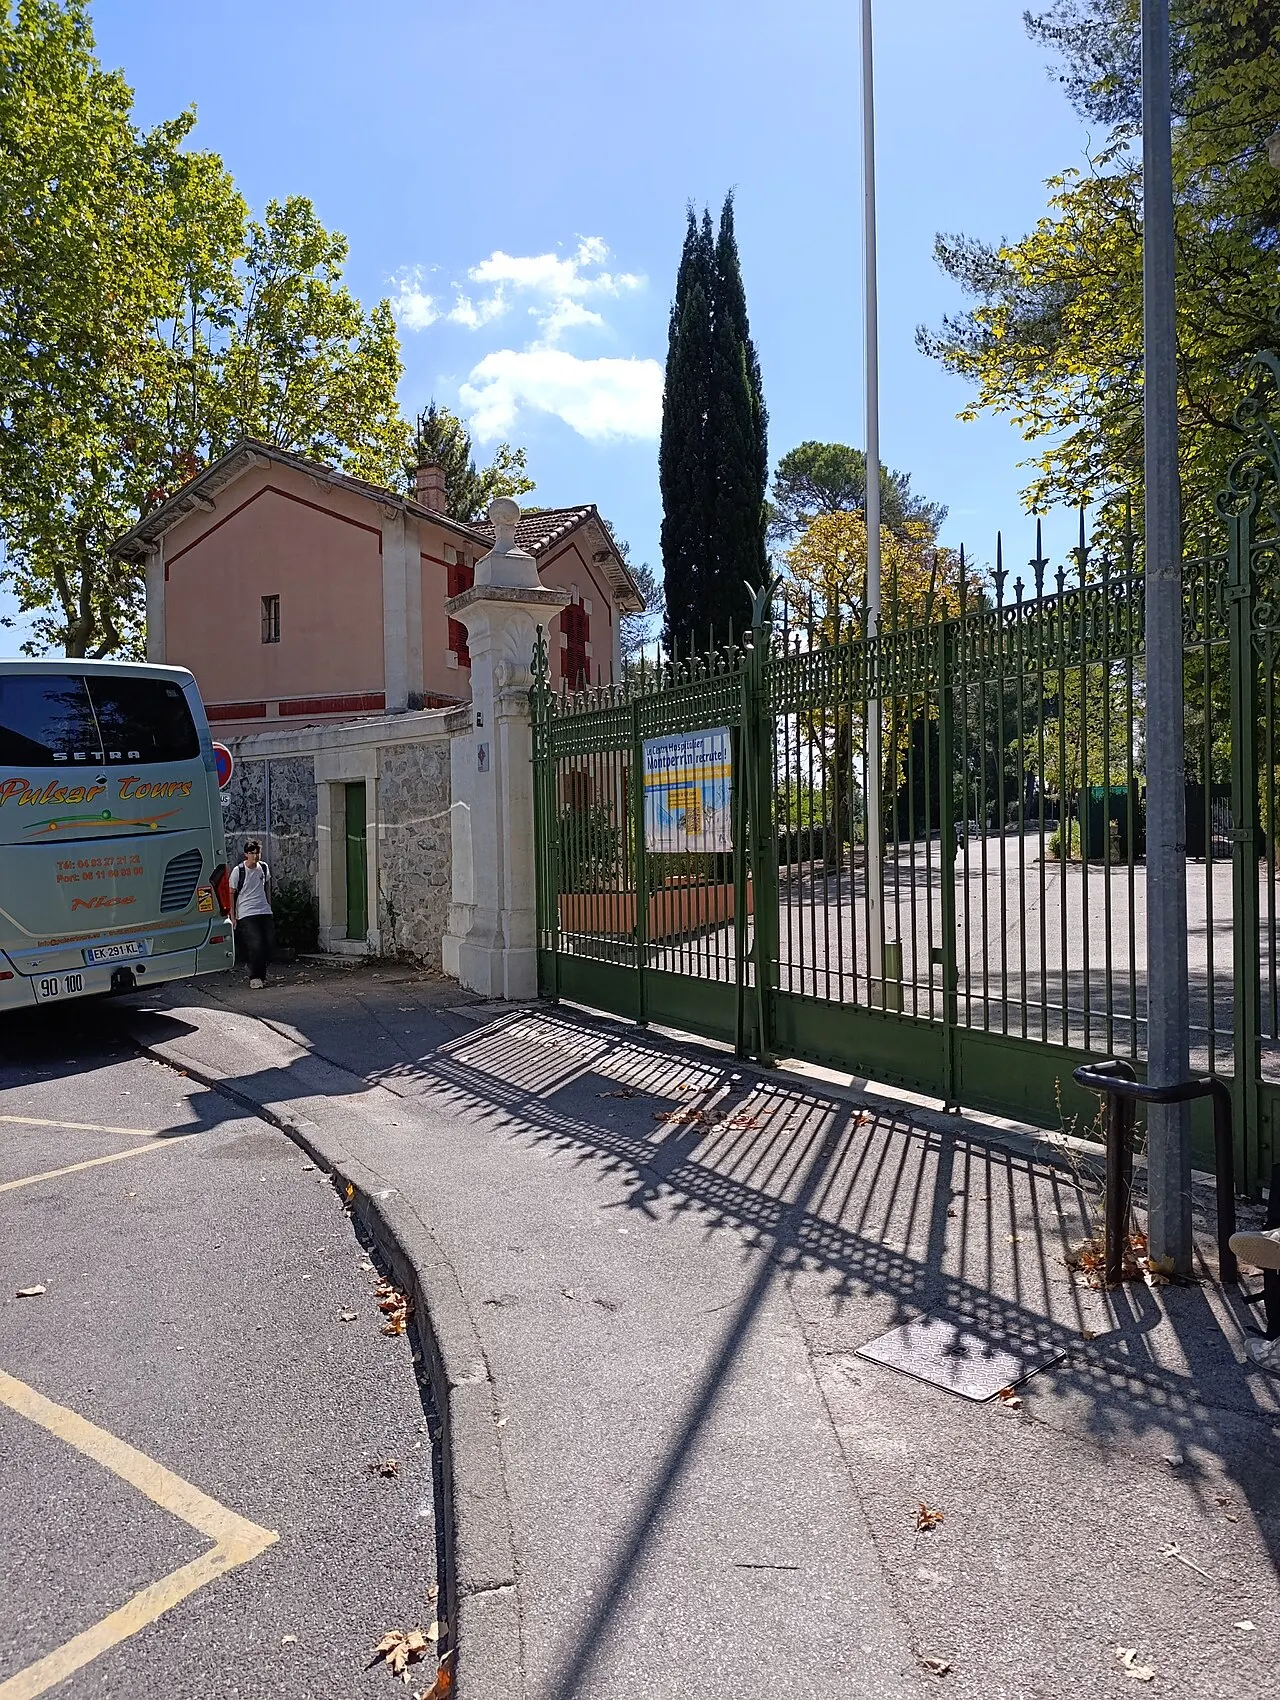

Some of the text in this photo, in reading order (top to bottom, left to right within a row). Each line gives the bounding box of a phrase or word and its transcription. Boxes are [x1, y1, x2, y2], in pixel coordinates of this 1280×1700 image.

[53, 750, 140, 761] SETRA
[653, 745, 668, 756] Centre
[669, 738, 704, 753] Hospitalier
[647, 752, 693, 771] Montperrin
[696, 750, 722, 764] recrute
[0, 777, 107, 807] Pulsar
[77, 859, 89, 869] 04
[71, 895, 137, 911] Nice
[41, 973, 83, 998] 90 100
